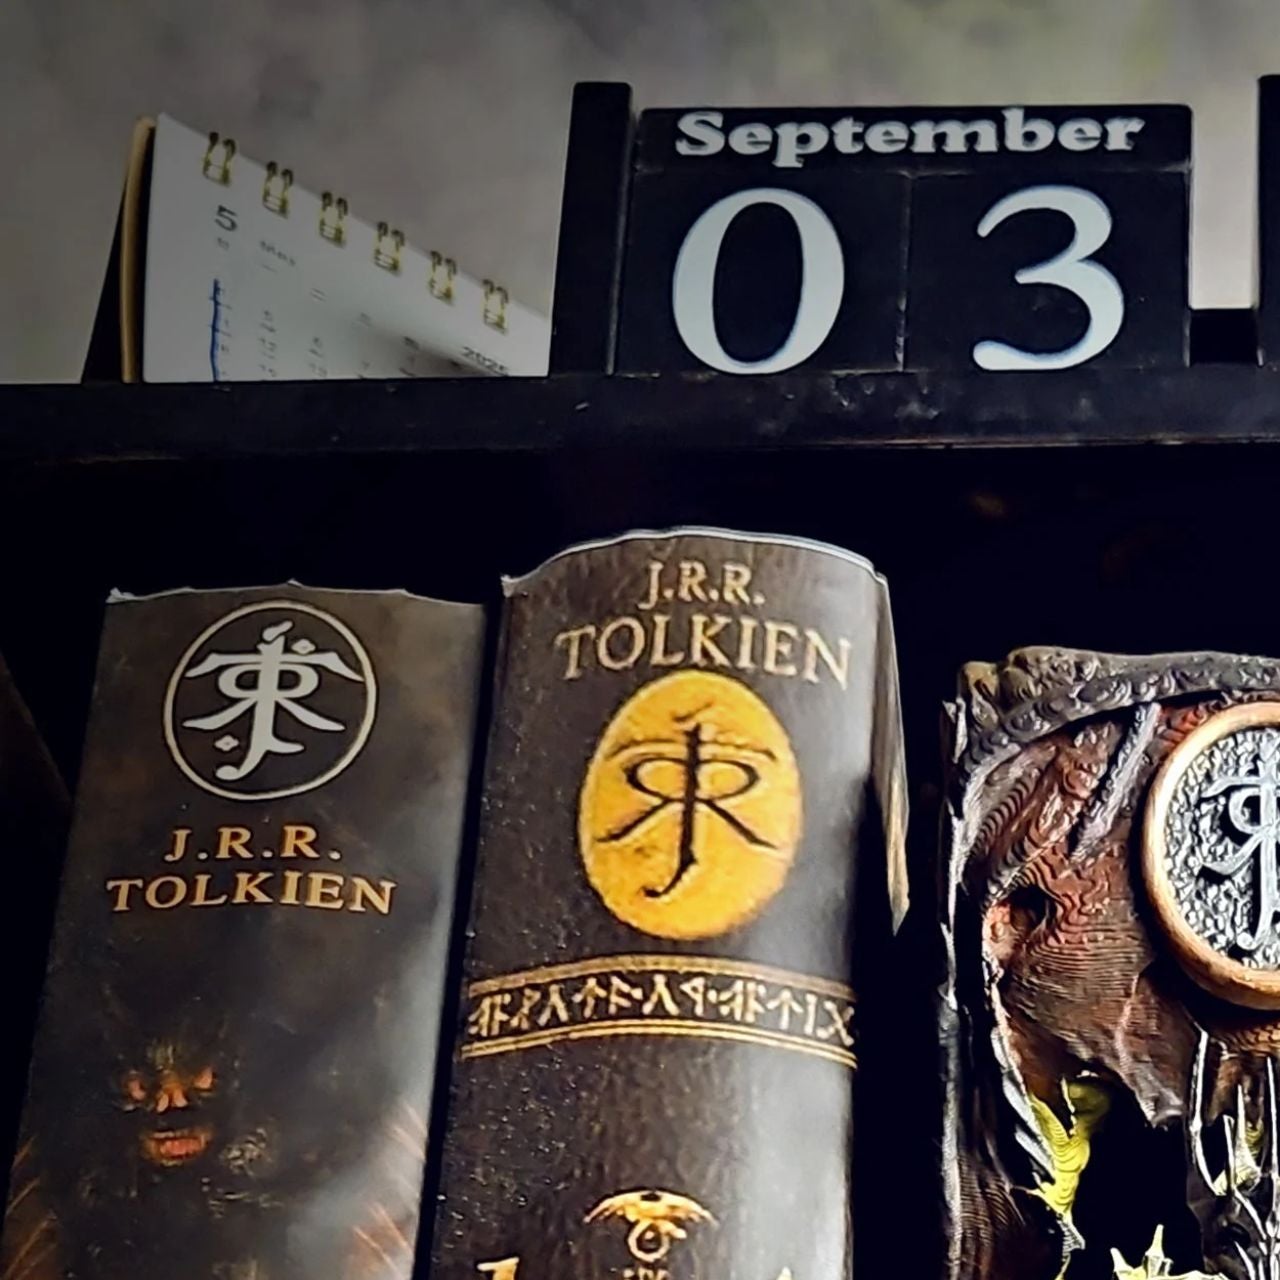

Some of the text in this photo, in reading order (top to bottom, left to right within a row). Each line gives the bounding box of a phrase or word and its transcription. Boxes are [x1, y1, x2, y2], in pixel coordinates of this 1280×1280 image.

[674, 107, 1145, 168] September
[214, 205, 238, 233] 5
[641, 560, 765, 609] J.R.R.
[555, 613, 853, 690] TOLKIEN
[165, 824, 342, 863] J.R.R.
[106, 871, 397, 915] TOLKIEN
